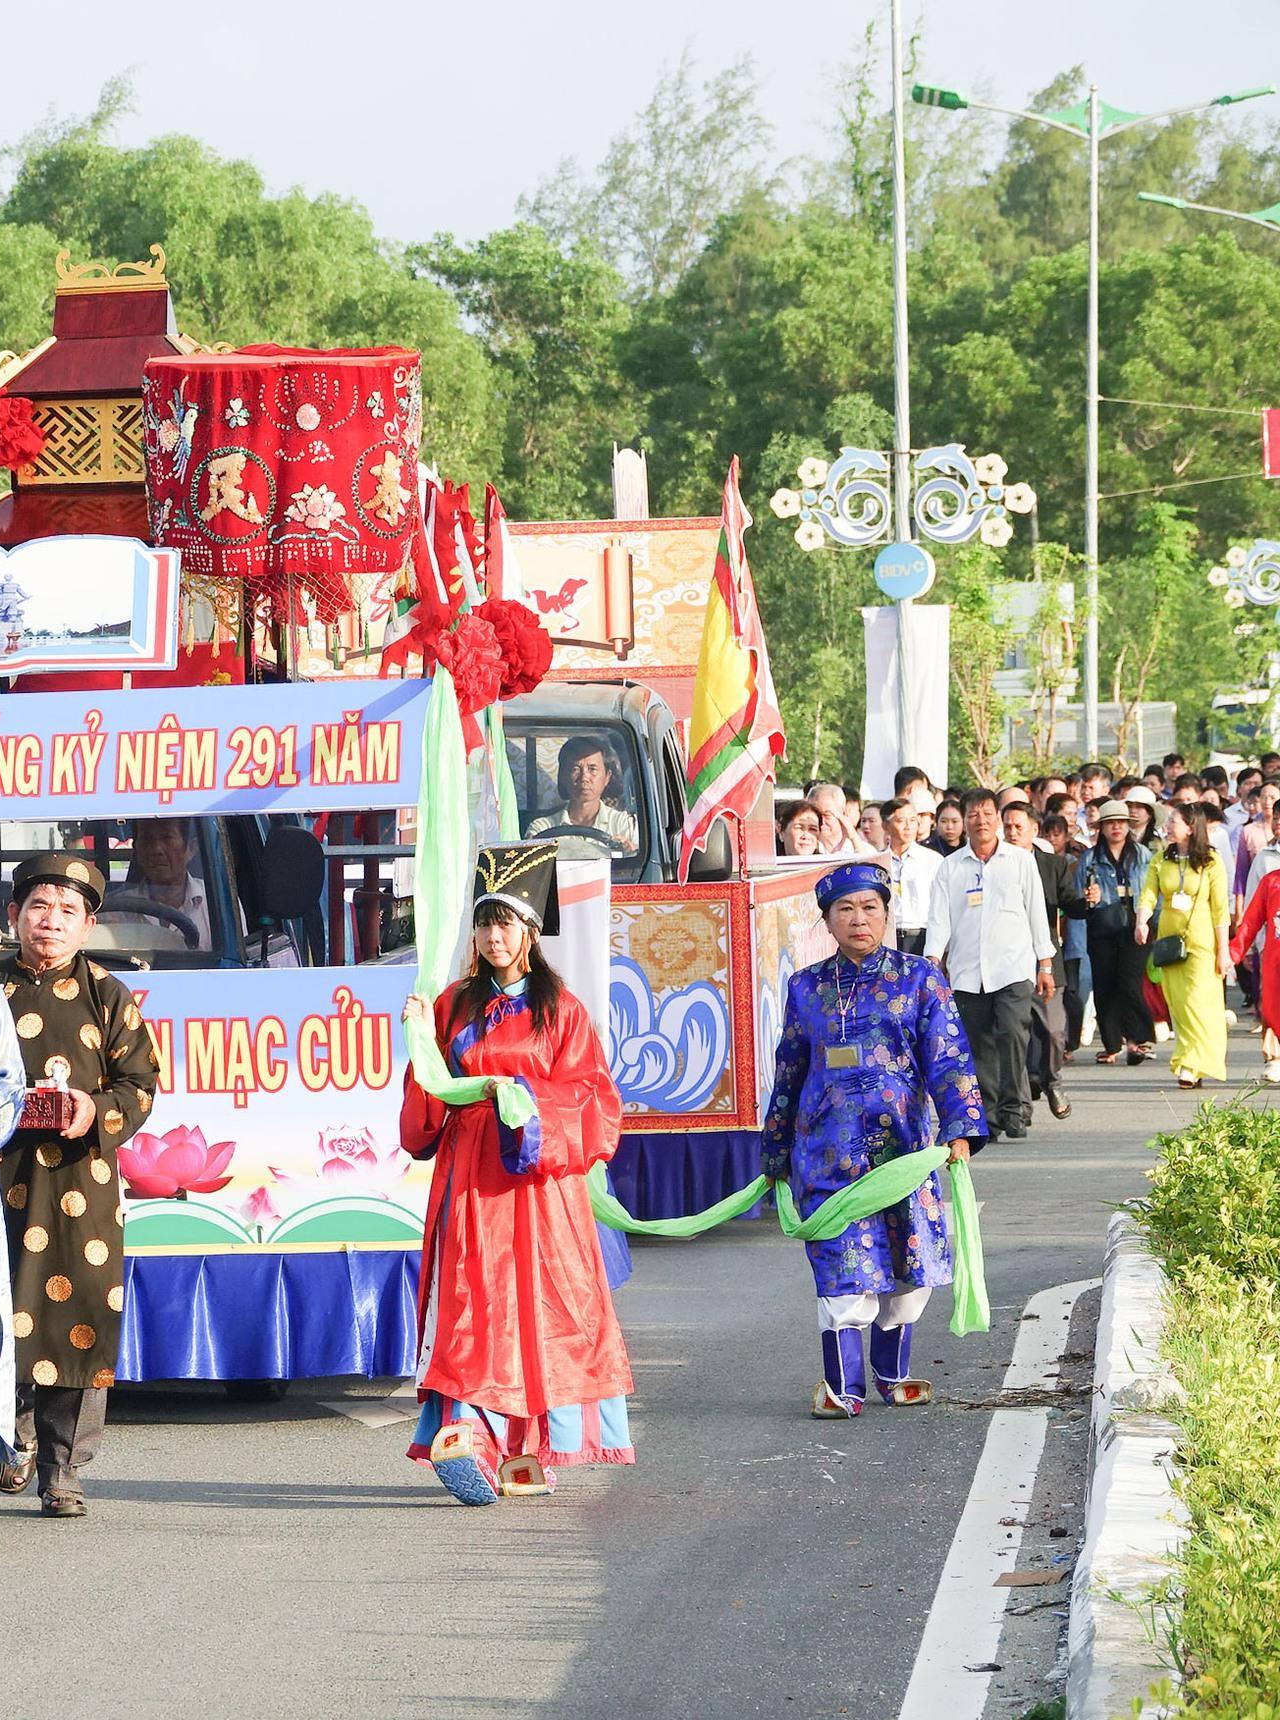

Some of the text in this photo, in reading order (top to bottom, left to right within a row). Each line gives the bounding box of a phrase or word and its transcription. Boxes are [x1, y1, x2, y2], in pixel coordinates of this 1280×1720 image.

[48, 709, 109, 795] KỶ
[115, 713, 219, 804] NIỆM
[224, 725, 301, 790] 291
[309, 710, 402, 786] NĂM
[184, 1014, 289, 1109] MẠC
[296, 985, 393, 1093] CỬU
